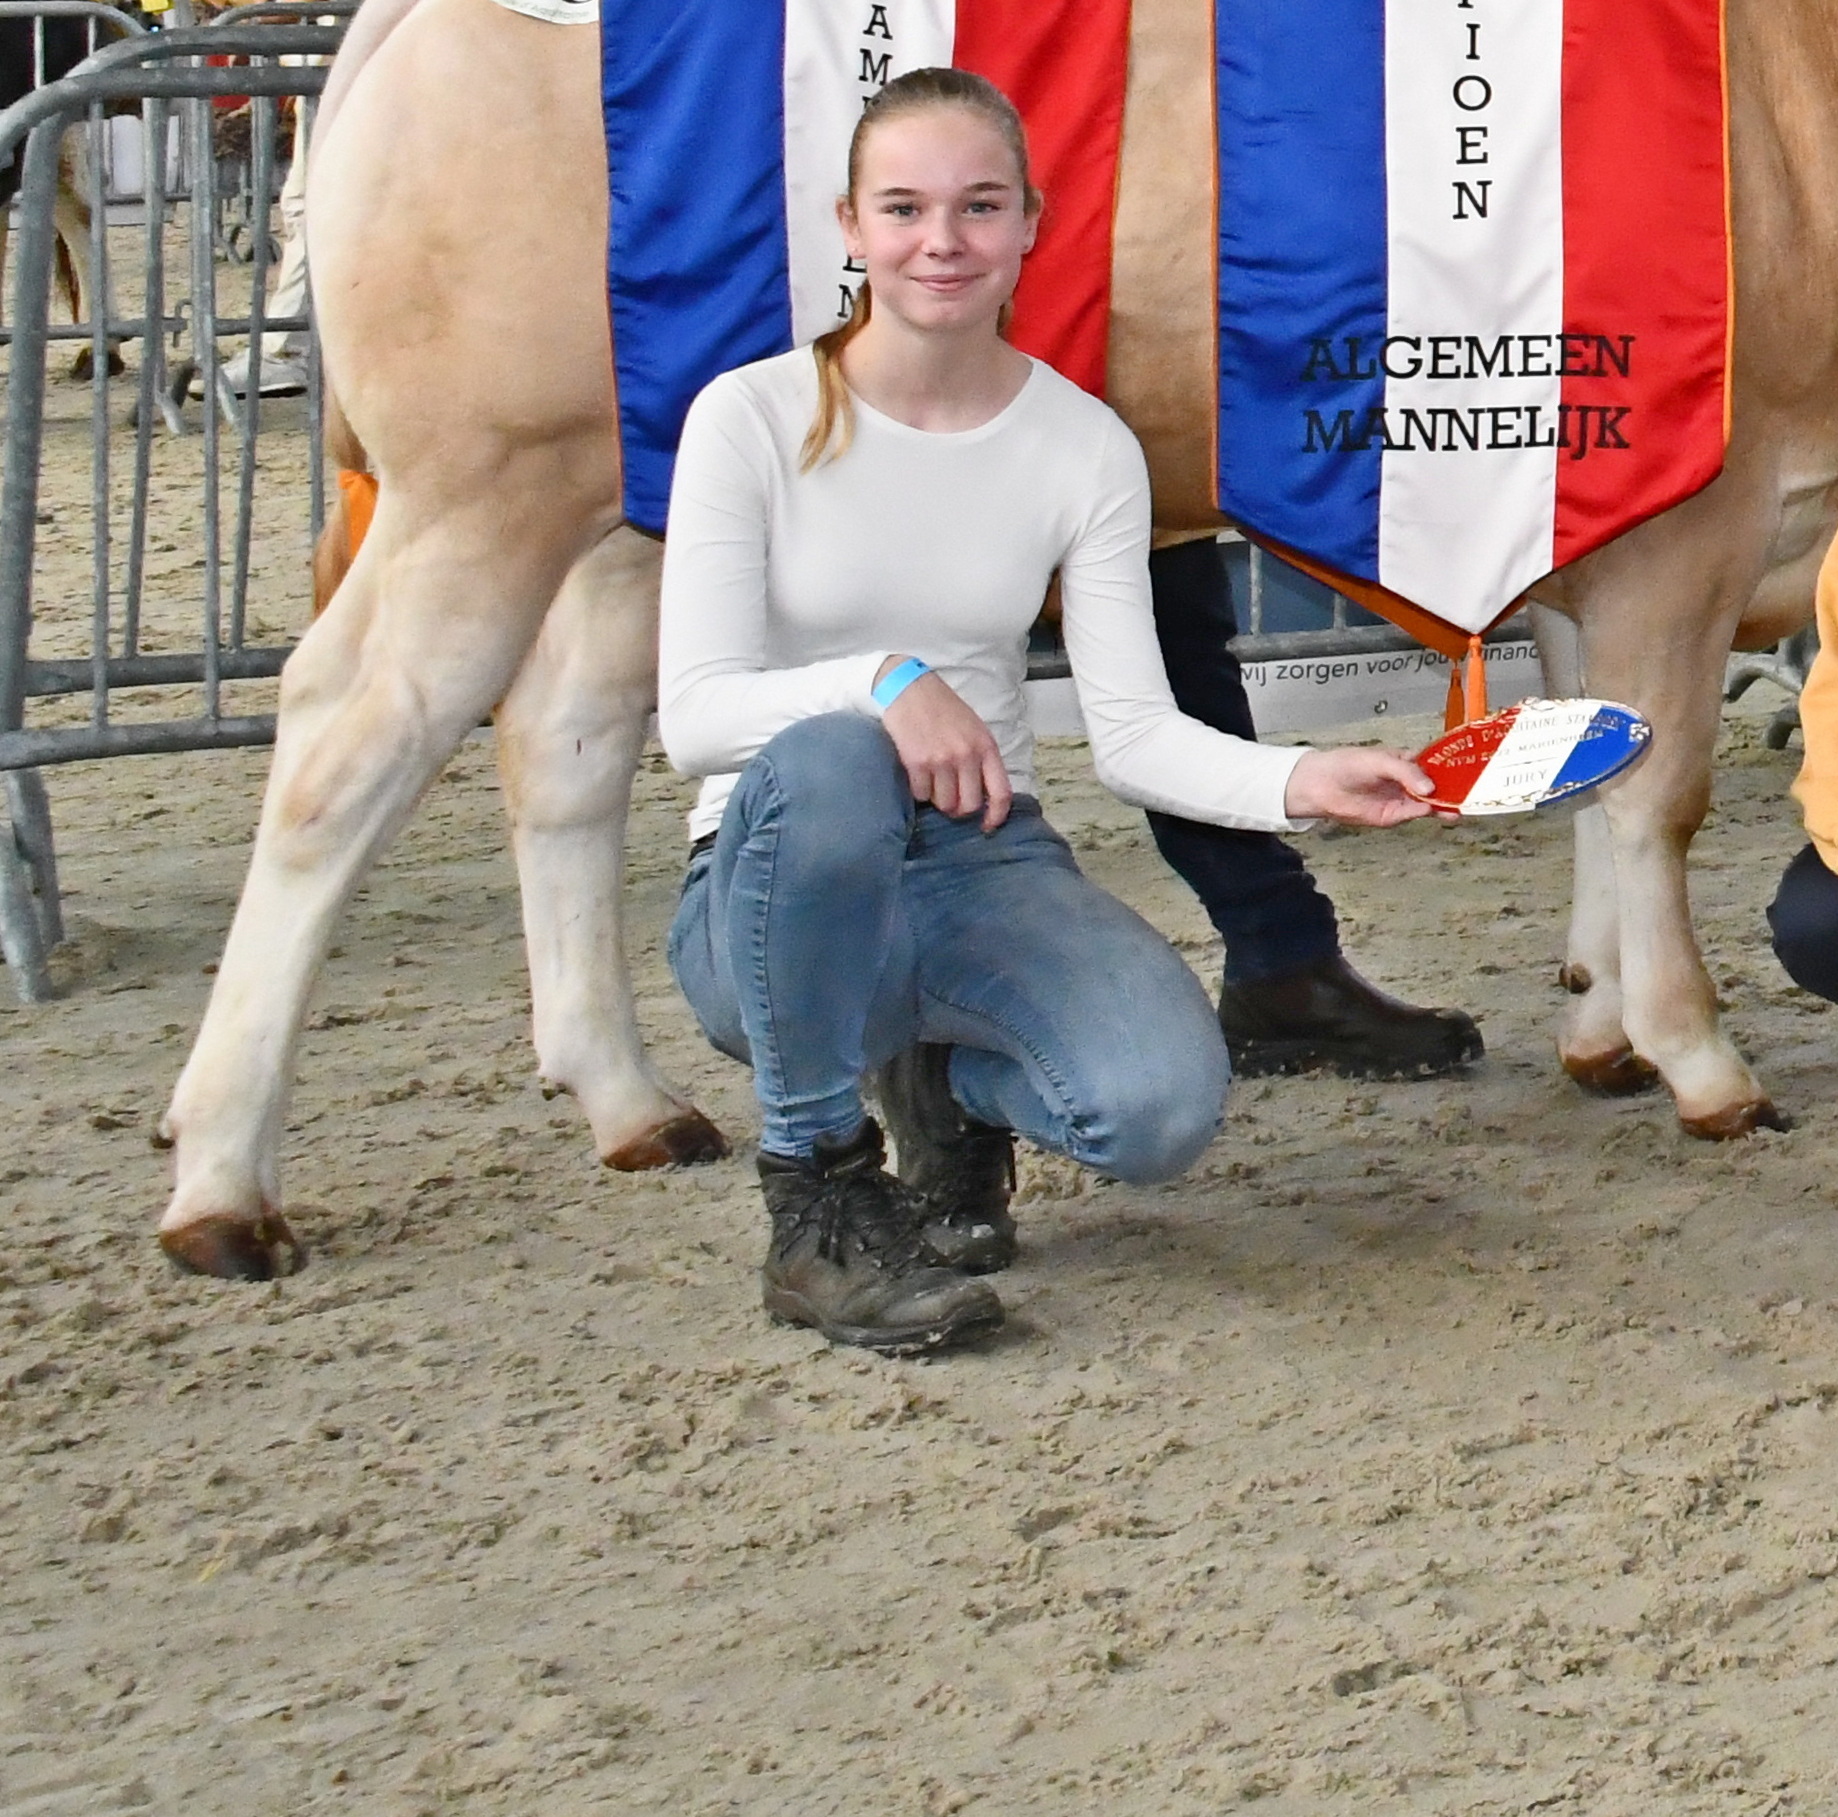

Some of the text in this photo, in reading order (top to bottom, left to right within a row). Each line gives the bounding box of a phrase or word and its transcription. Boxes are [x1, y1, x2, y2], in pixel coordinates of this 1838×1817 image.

[1301, 333, 1635, 380] ALGEMEEN
[1301, 406, 1632, 461] MANNELIJK
[1277, 661, 1359, 685] zorgen
[1367, 655, 1410, 675] voor
